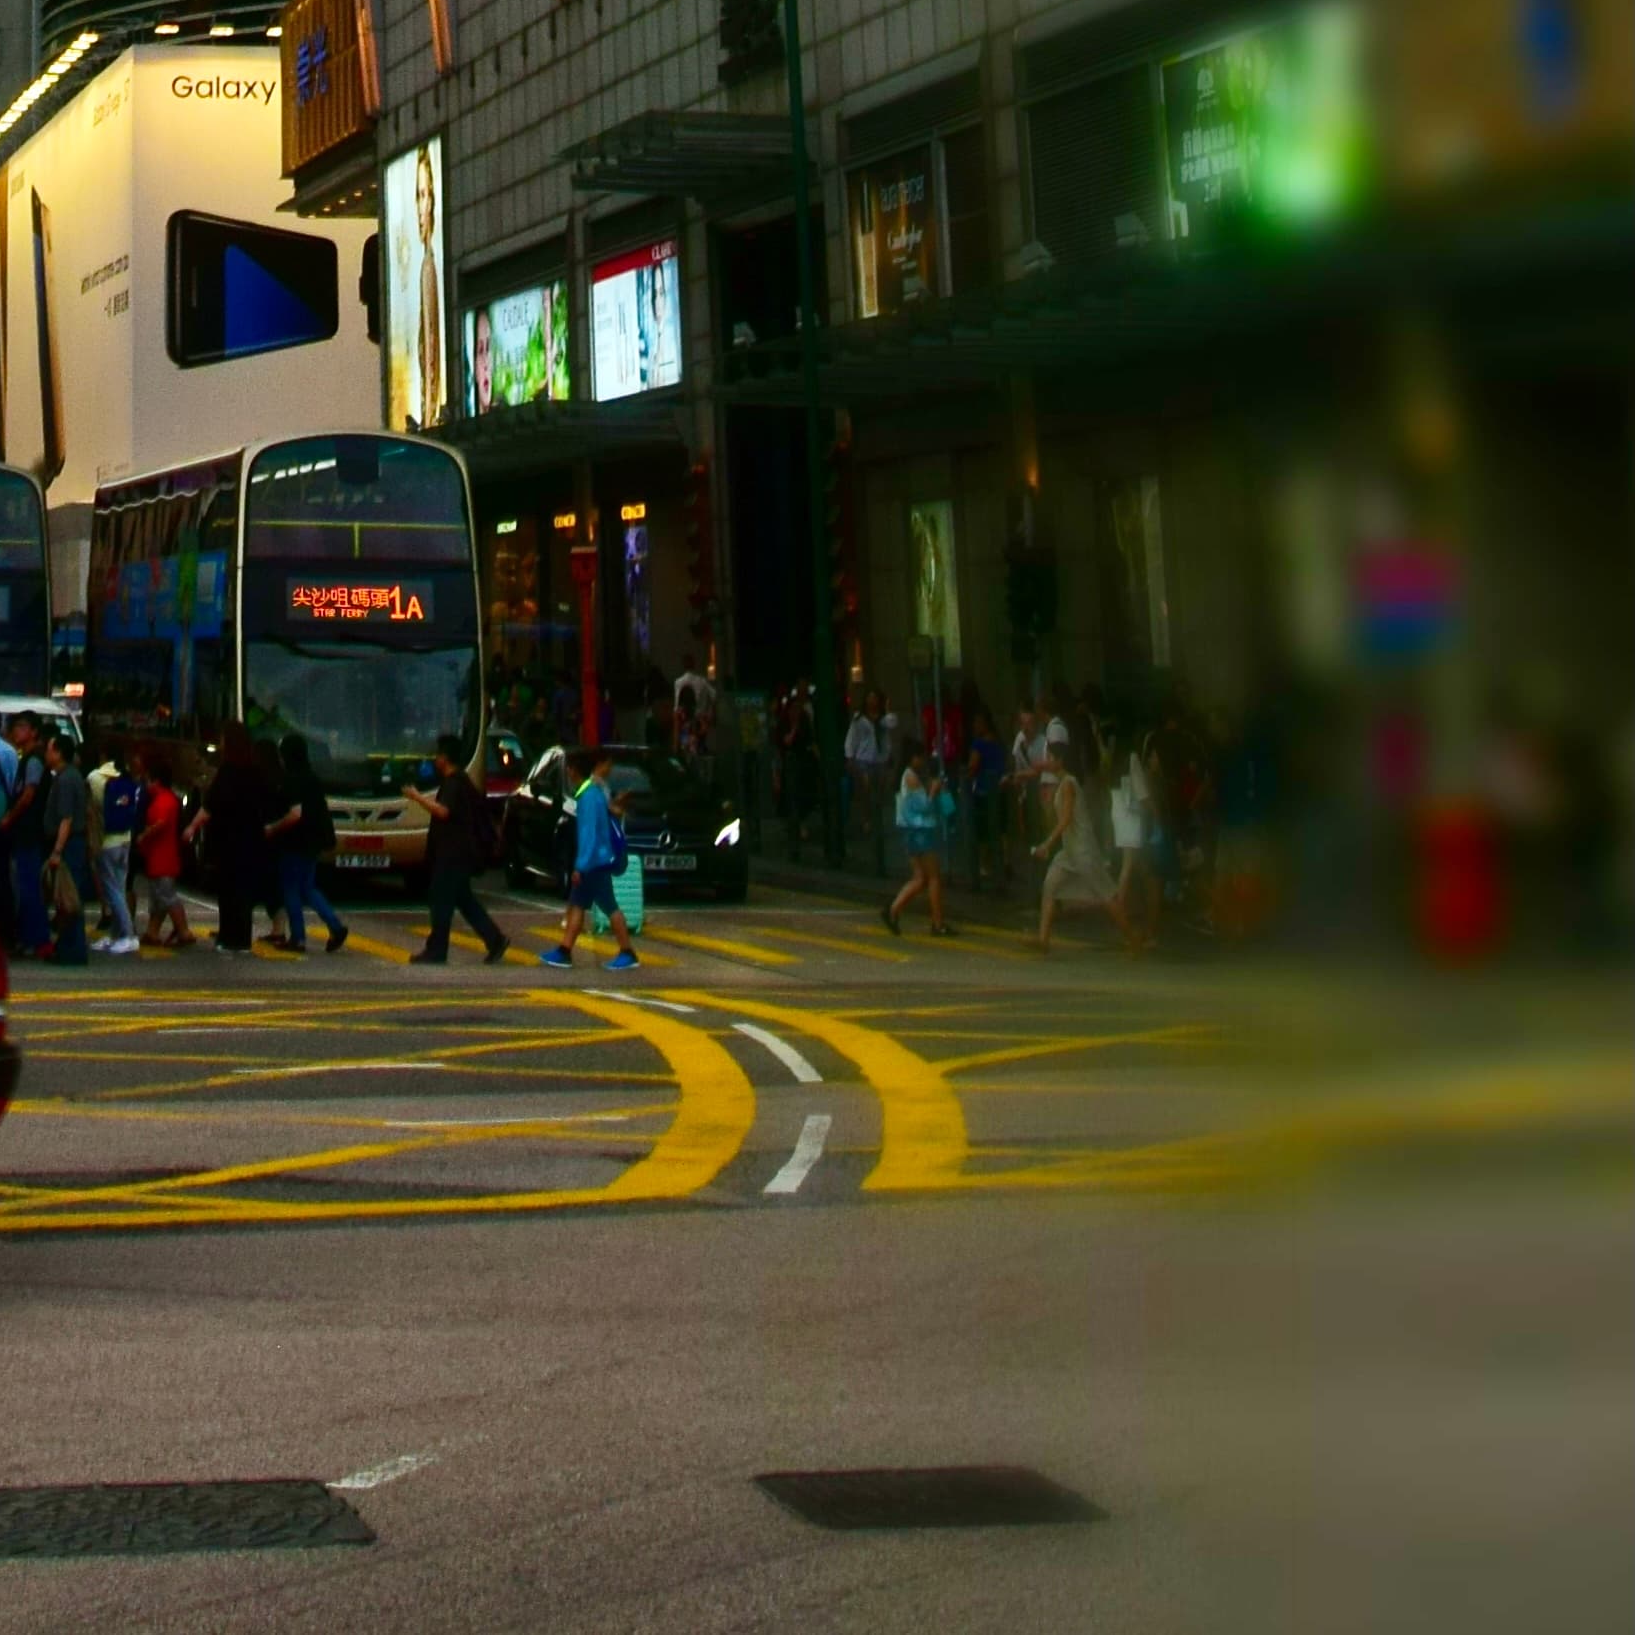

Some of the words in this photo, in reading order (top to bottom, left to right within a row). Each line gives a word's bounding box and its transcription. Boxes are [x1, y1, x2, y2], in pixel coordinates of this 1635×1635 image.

[171, 76, 277, 105] Galaxy
[292, 585, 389, 608] 尖沙咀碼頭
[390, 585, 424, 619] 1A
[313, 608, 336, 618] STAR
[341, 608, 369, 618] FERRY
